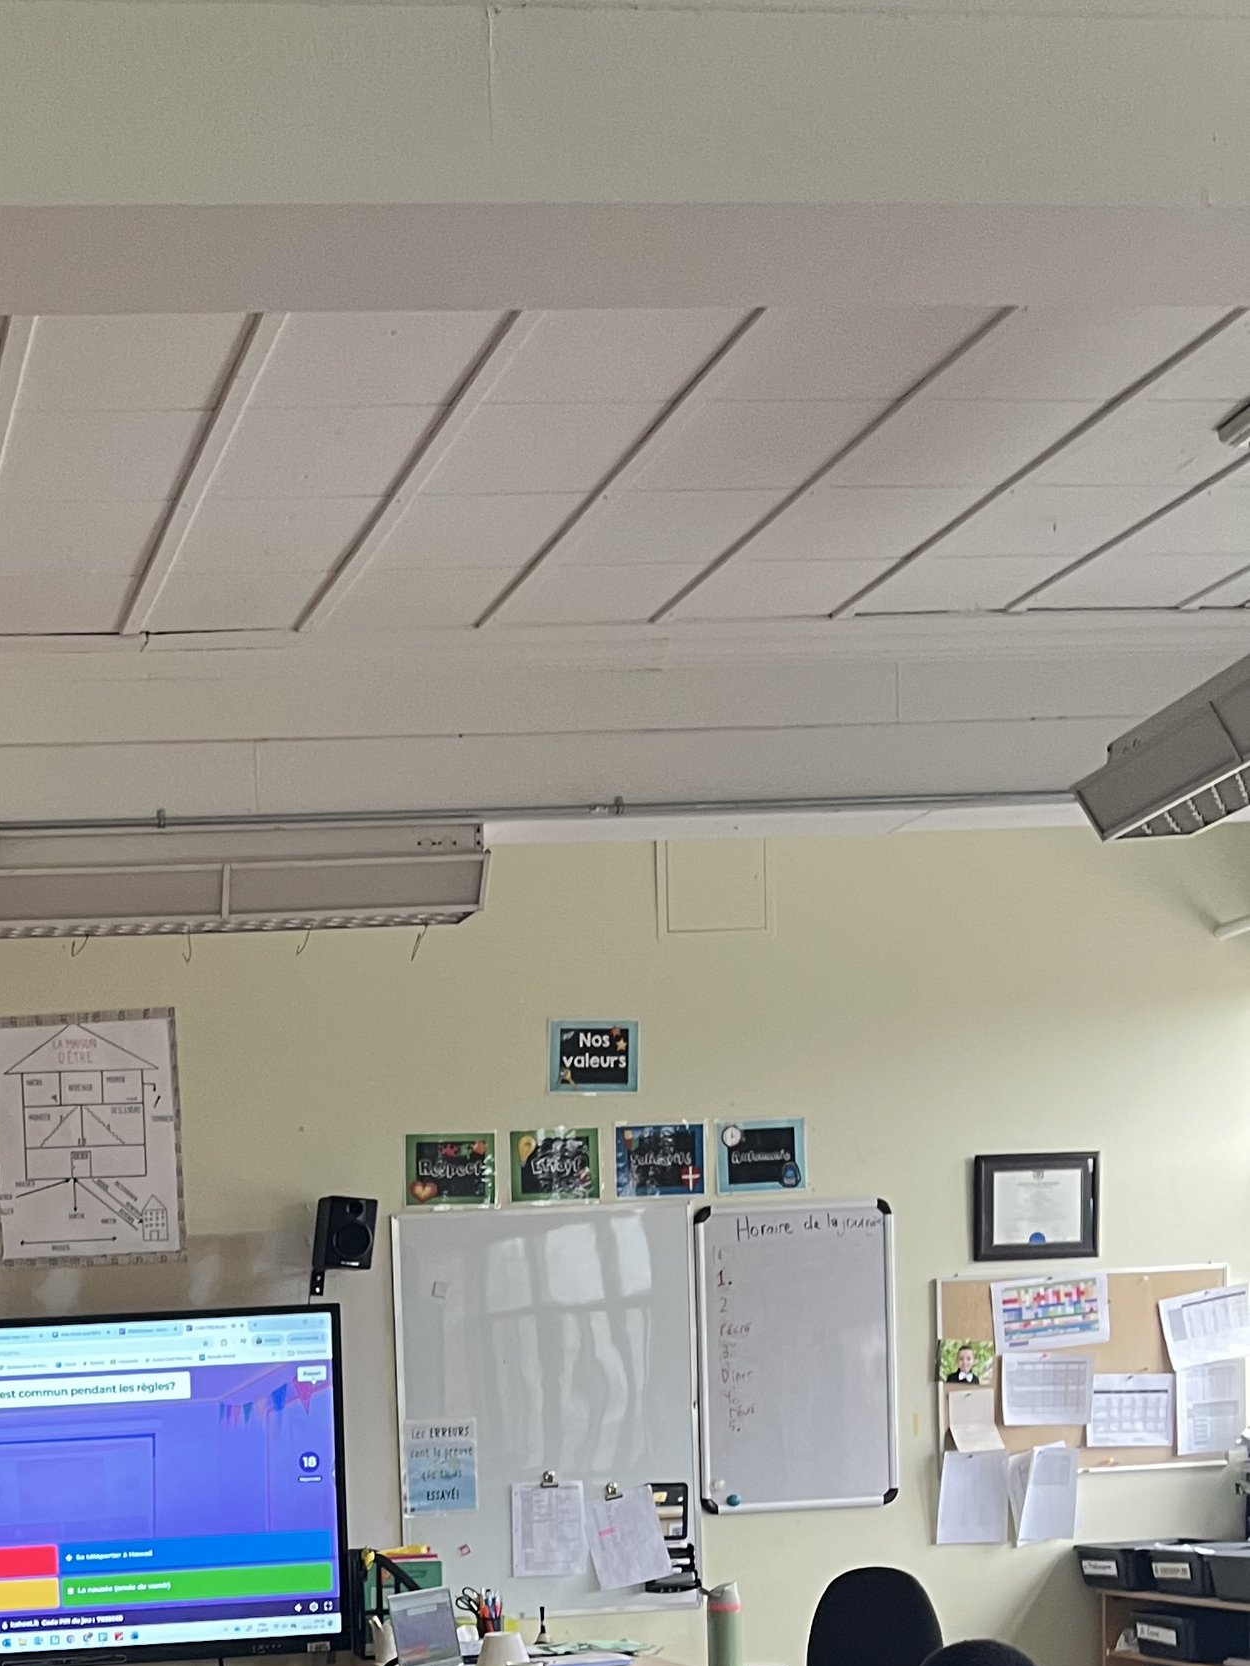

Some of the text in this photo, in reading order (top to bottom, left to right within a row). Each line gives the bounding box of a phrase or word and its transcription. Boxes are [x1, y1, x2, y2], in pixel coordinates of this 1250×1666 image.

[52, 1040, 63, 1049] LA
[579, 1032, 610, 1048] Nos
[562, 1052, 627, 1068] valeurs
[736, 1215, 794, 1242] Horaire
[804, 1214, 821, 1231] de
[827, 1212, 838, 1228] la
[0, 1390, 16, 1399] est
[18, 1388, 68, 1398] commun
[70, 1384, 117, 1397] pendant
[119, 1383, 135, 1393] les
[137, 1381, 176, 1394] règles?
[430, 1426, 469, 1439] ERREURS
[302, 1456, 317, 1468] 18
